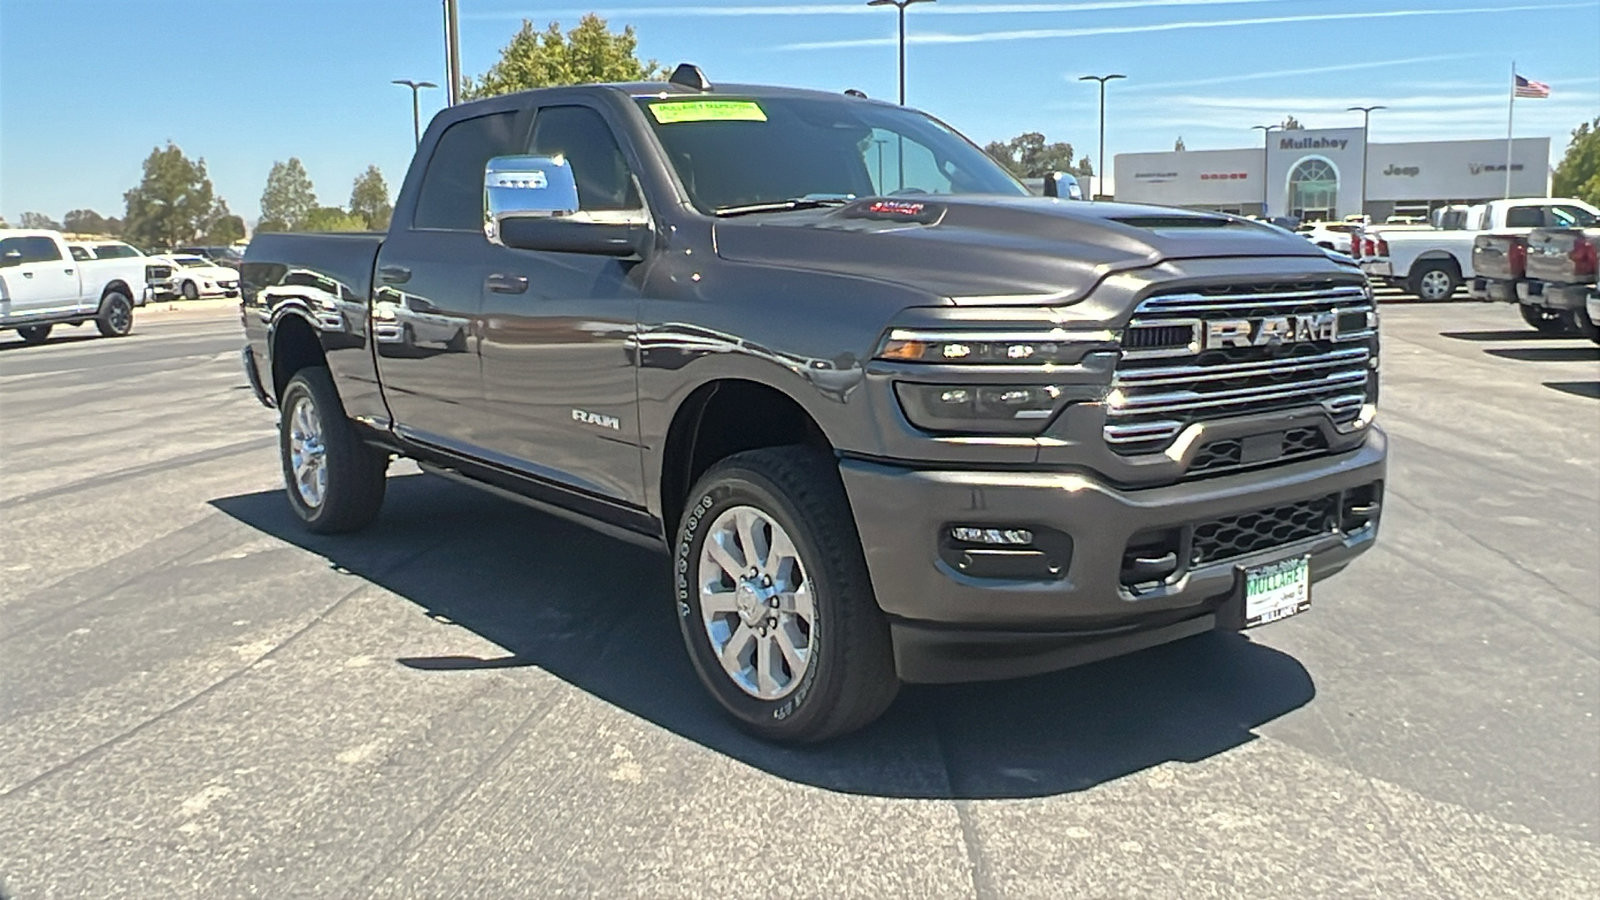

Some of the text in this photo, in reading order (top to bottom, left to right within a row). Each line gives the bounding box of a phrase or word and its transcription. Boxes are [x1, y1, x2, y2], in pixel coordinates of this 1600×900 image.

[1280, 138, 1348, 151] Mullahey
[1383, 164, 1420, 177] Jeep
[1206, 313, 1337, 350] RAM
[572, 409, 619, 430] RAM
